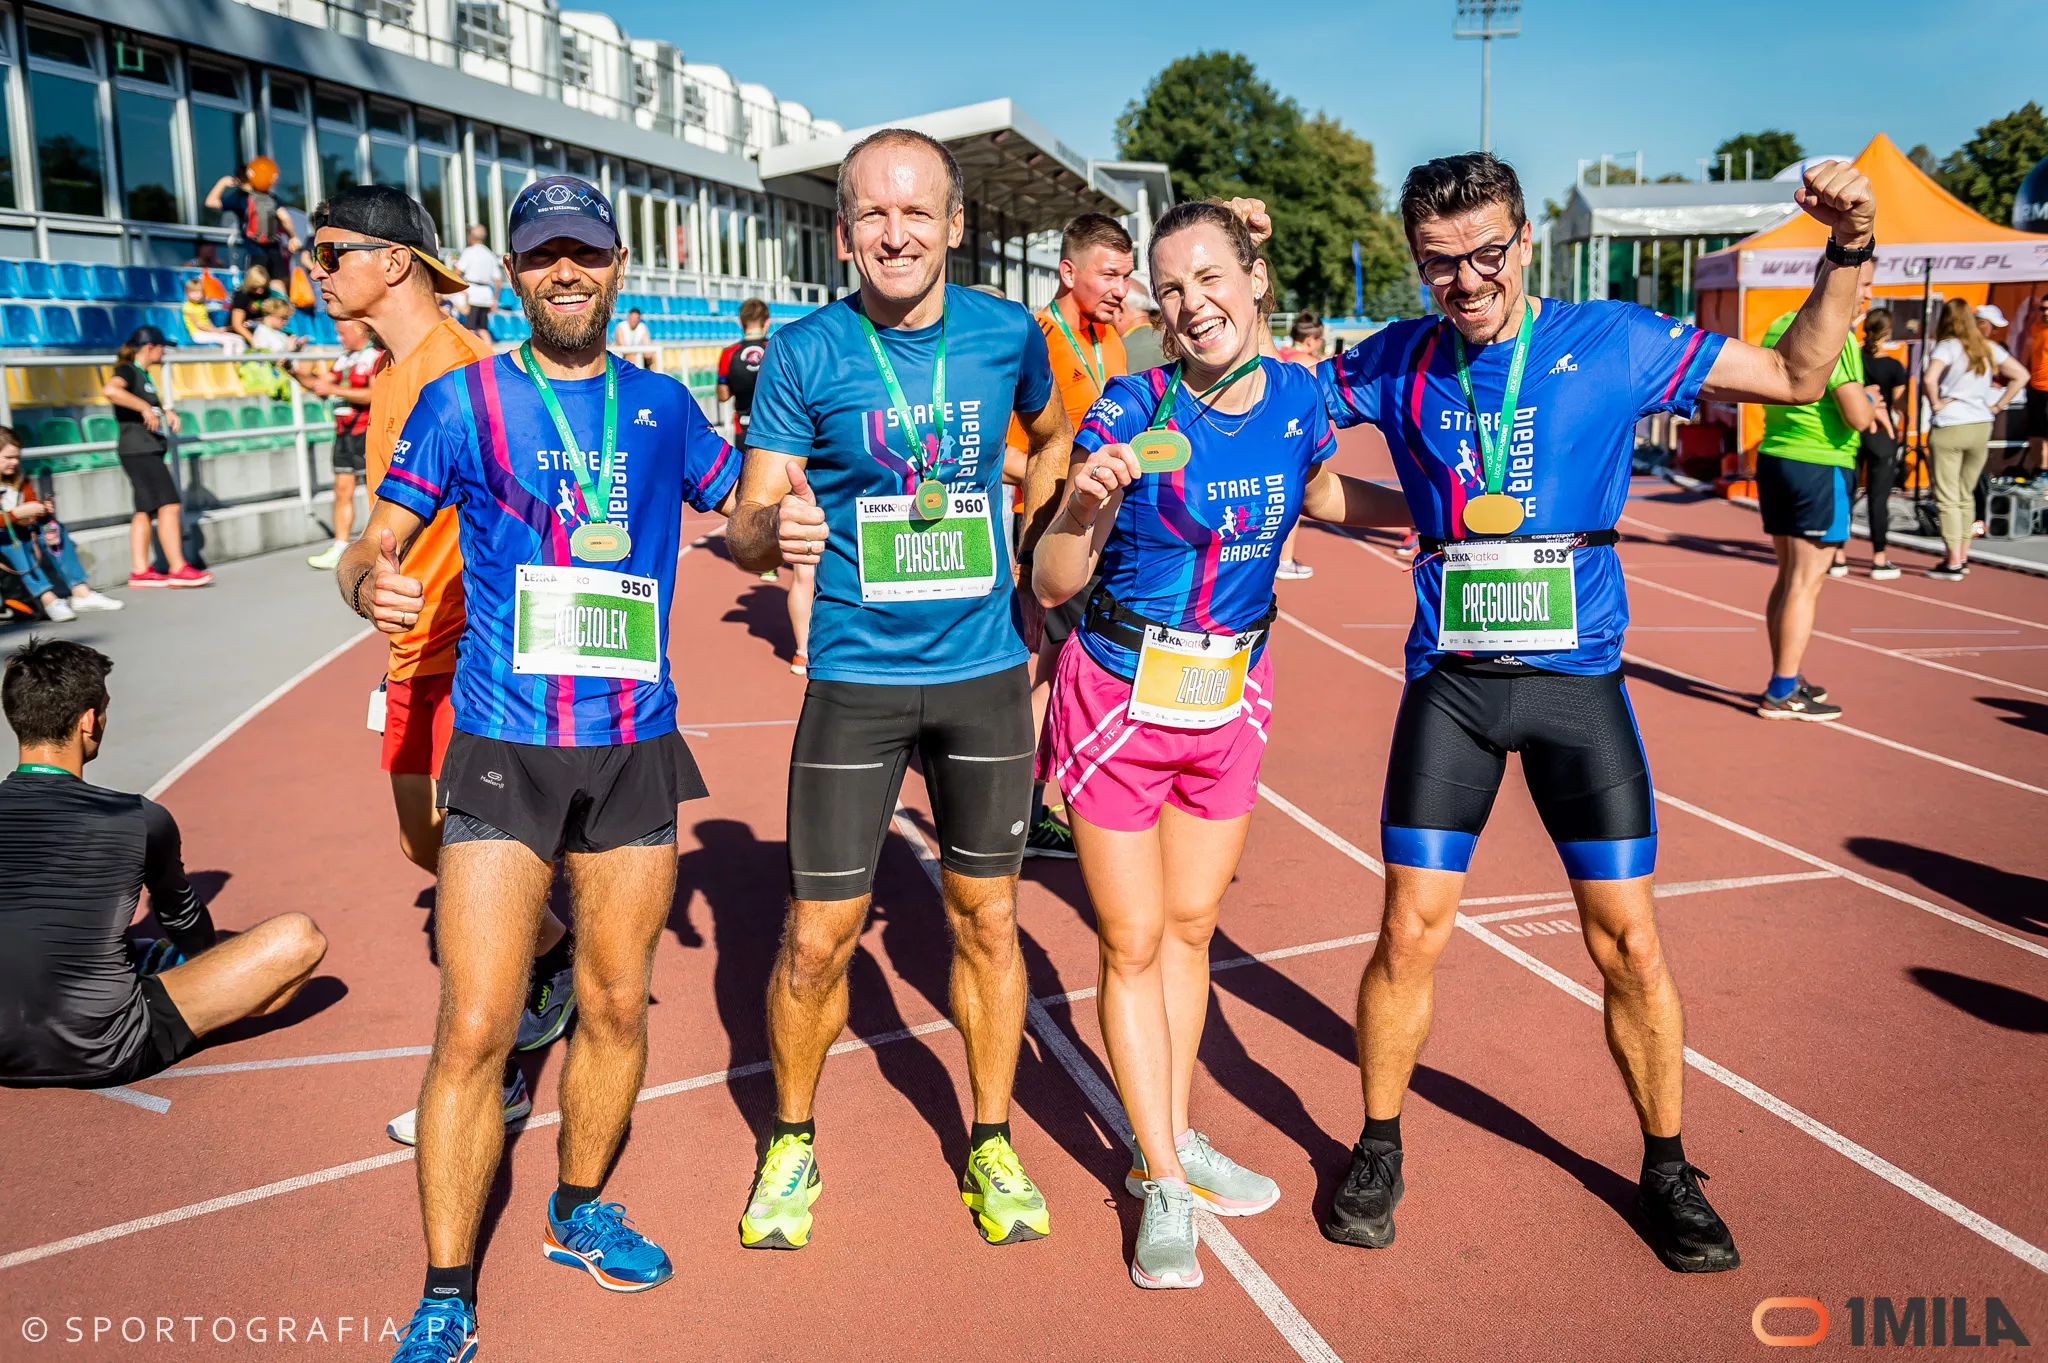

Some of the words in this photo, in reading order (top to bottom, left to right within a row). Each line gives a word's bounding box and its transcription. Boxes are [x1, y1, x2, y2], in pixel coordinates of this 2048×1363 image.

[883, 367, 894, 383] 2021
[1509, 378, 1518, 394] 2021
[1207, 477, 1261, 501] STARE
[954, 499, 984, 513] 960
[894, 530, 966, 573] PIASECKI
[1219, 542, 1273, 562] BABICE
[1533, 549, 1567, 564] 893
[621, 579, 652, 598] 950
[1462, 581, 1550, 631] PRĘGOWSKI
[1175, 666, 1230, 705] ZAŁOGA
